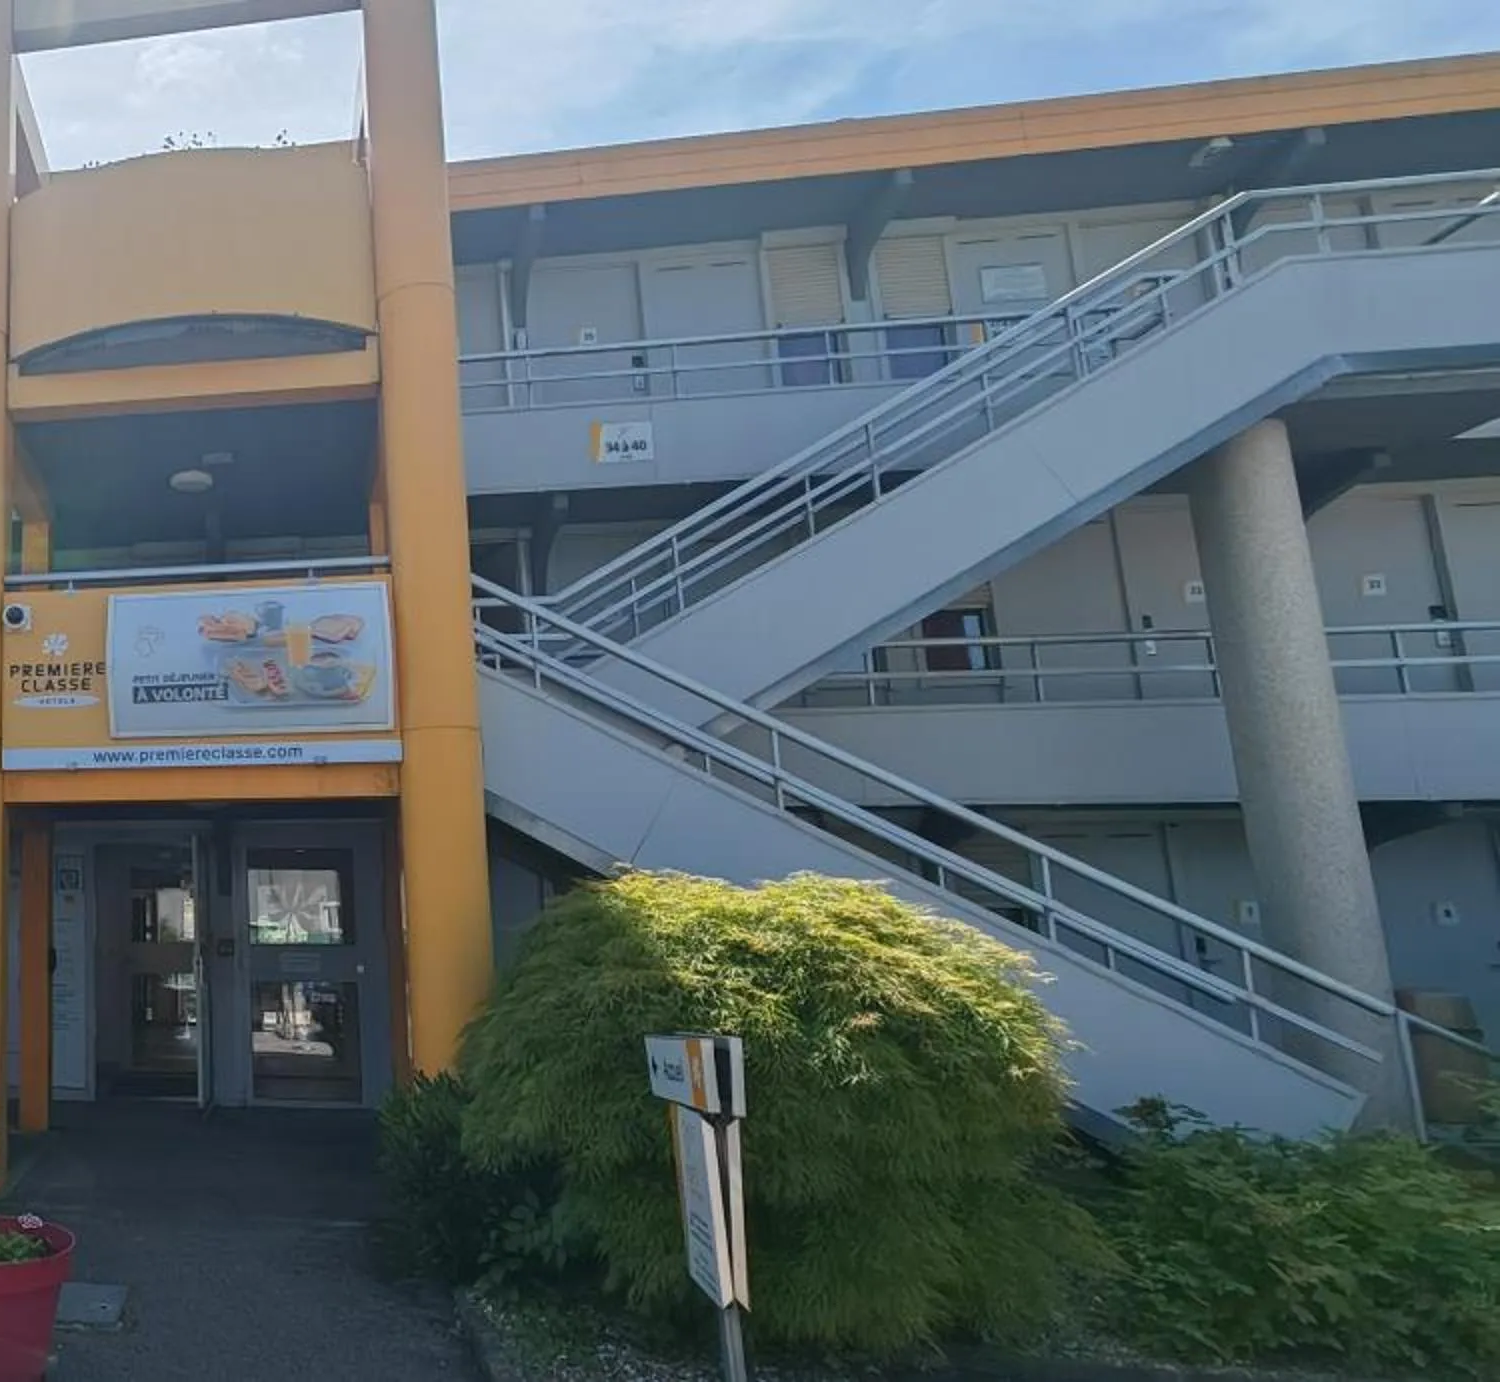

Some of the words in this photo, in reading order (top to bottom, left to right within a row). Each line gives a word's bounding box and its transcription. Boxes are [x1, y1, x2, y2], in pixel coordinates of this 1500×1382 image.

[9, 662, 106, 678] PREMIERE
[21, 678, 92, 692] CLASSE
[151, 684, 226, 702] VOLONTÉ
[93, 746, 303, 764] www.premiereclasse.com
